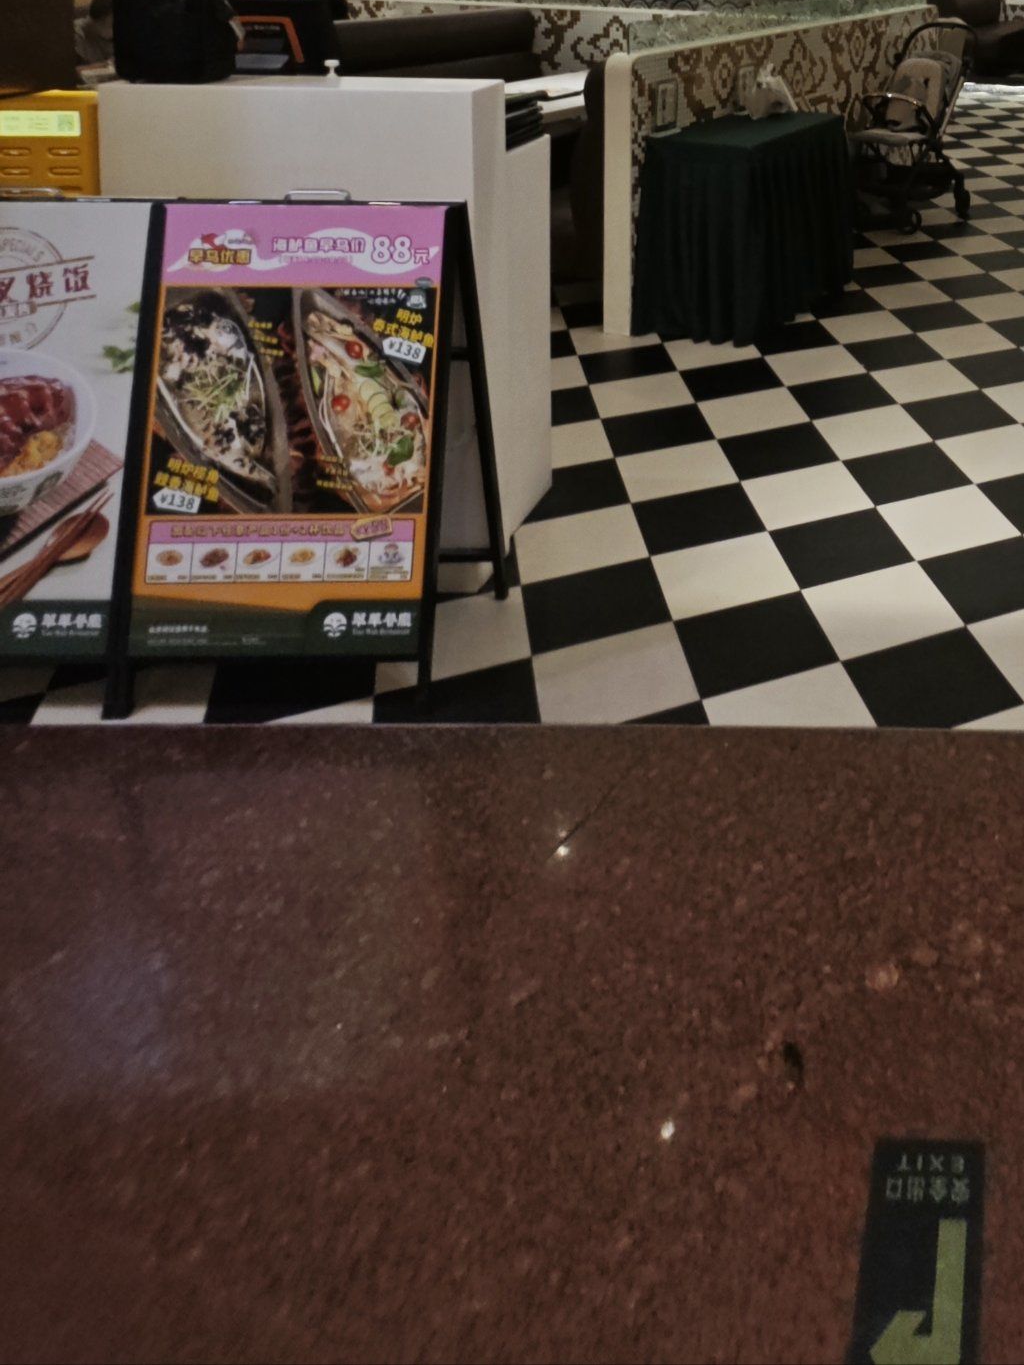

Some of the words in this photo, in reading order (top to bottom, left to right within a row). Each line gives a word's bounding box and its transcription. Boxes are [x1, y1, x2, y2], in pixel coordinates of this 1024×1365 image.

[388, 340, 422, 360] ¥138
[160, 493, 196, 511] ¥138
[897, 1153, 965, 1173] EXIT
[885, 1176, 970, 1203] 安全出口
